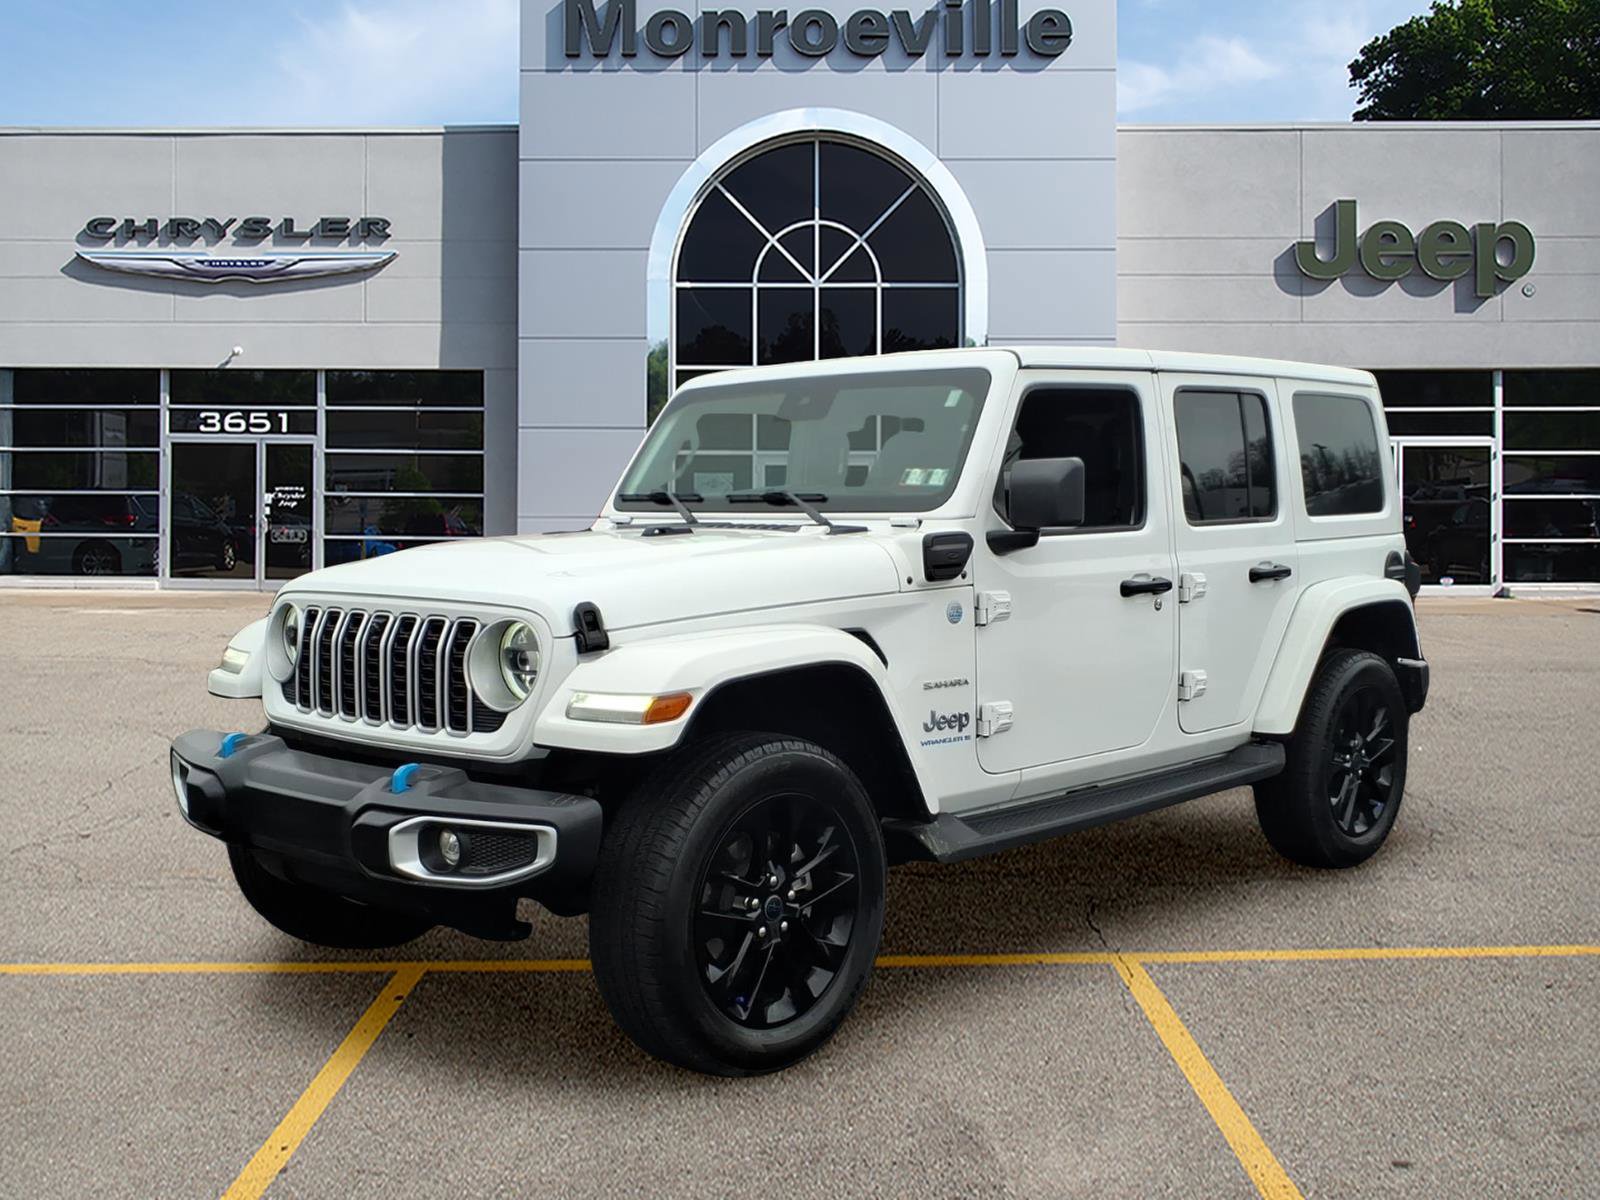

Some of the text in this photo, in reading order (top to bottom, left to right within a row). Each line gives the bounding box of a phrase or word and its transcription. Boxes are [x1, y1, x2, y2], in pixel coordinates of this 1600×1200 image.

[563, 0, 1074, 58] Monroeville
[86, 217, 392, 239] CHRYSLER
[1295, 199, 1536, 297] Jeep
[199, 412, 289, 433] 3651
[922, 679, 970, 691] SAHARA
[922, 709, 970, 733] Jeep
[920, 735, 964, 747] WRANGLER
